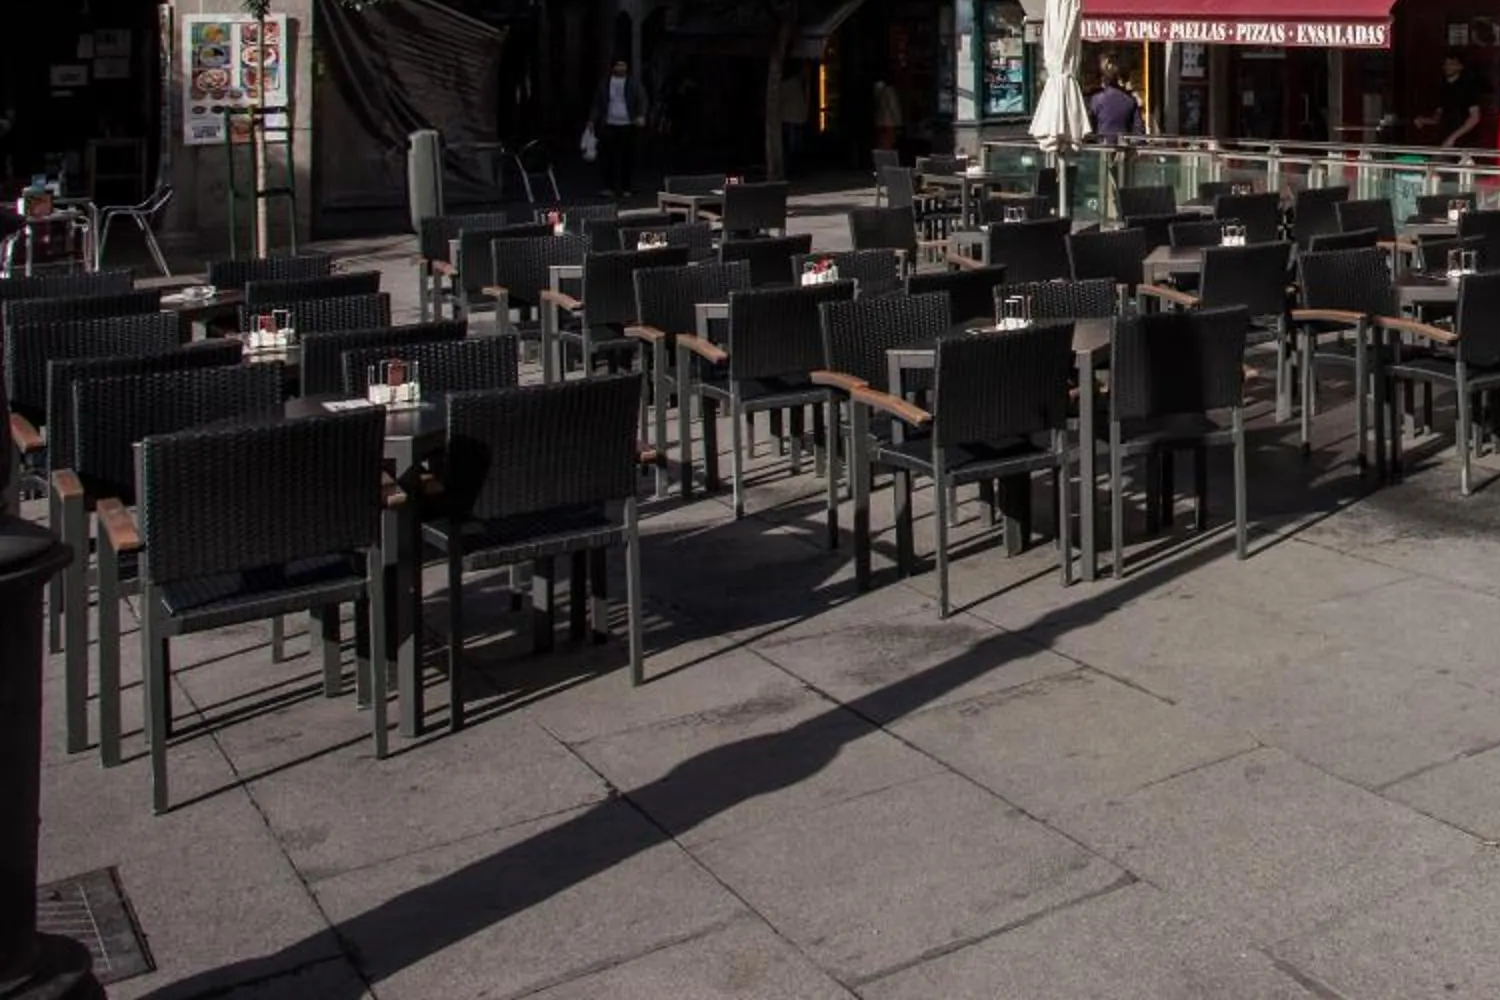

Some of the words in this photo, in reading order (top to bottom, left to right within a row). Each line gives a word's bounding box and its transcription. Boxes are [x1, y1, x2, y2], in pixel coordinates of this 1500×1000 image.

[1123, 20, 1161, 40] TAPAS
[1169, 22, 1226, 41] PAELLAS
[1235, 22, 1286, 43] PIZZAS
[1297, 24, 1386, 46] ENSALADAS
